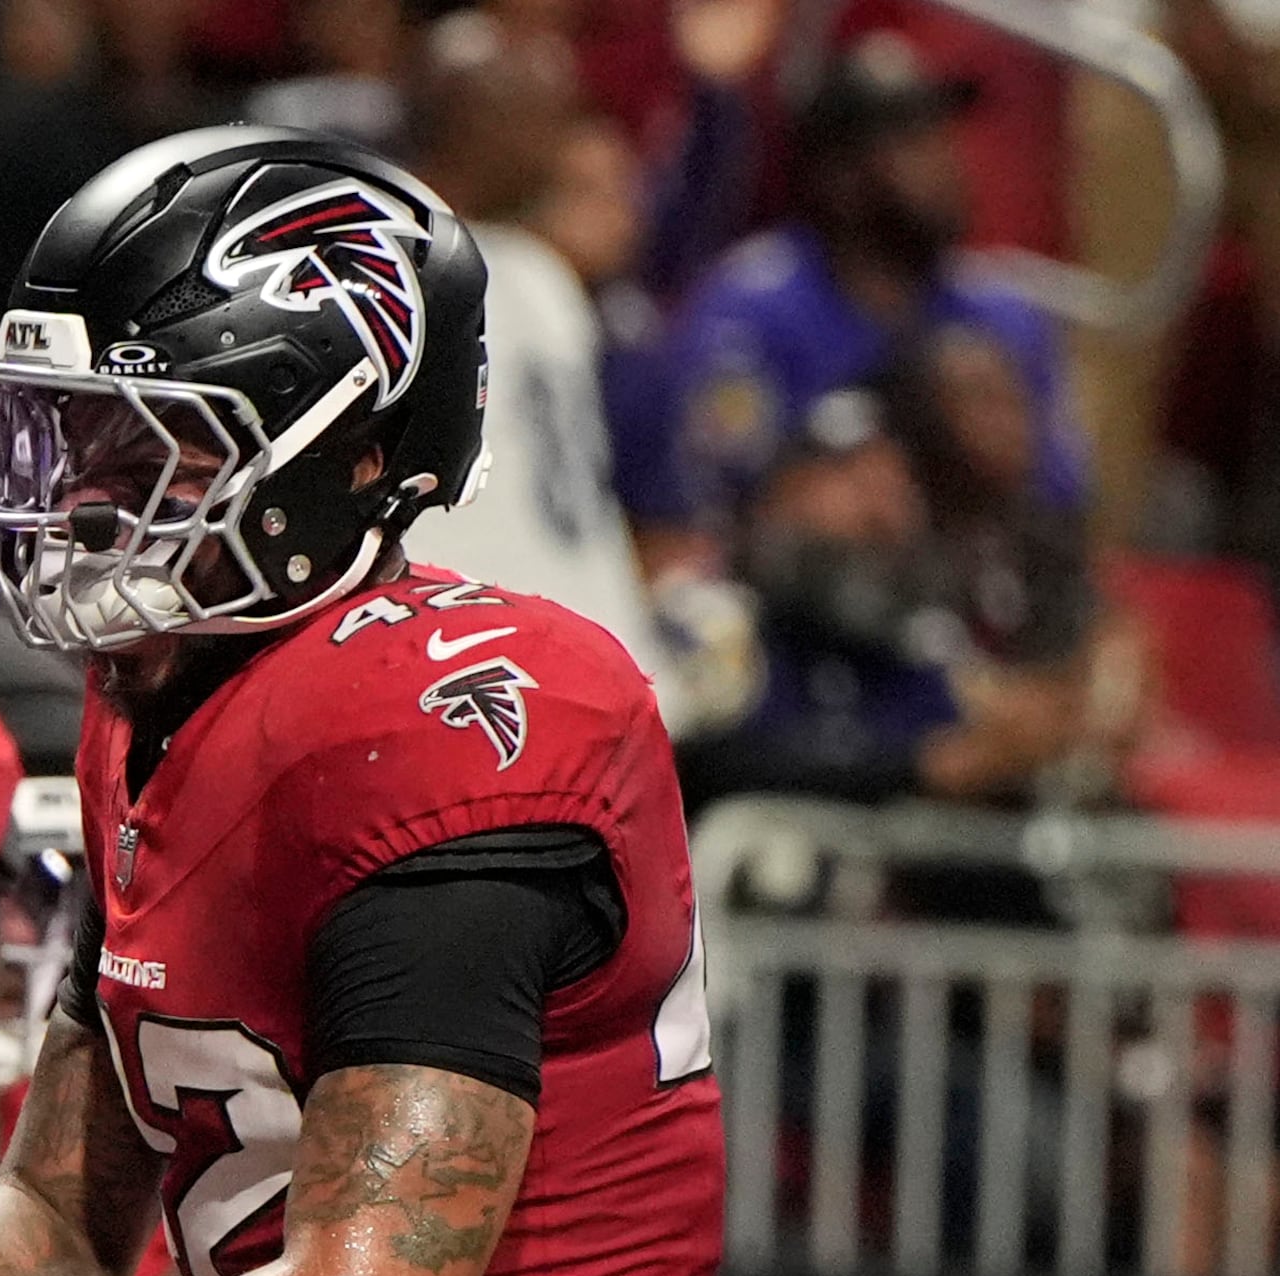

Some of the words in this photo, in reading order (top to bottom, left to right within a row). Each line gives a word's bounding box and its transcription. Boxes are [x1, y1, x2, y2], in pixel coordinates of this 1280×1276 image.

[4, 321, 51, 349] ATL
[99, 362, 169, 375] OAKLEY
[329, 583, 514, 647] 42
